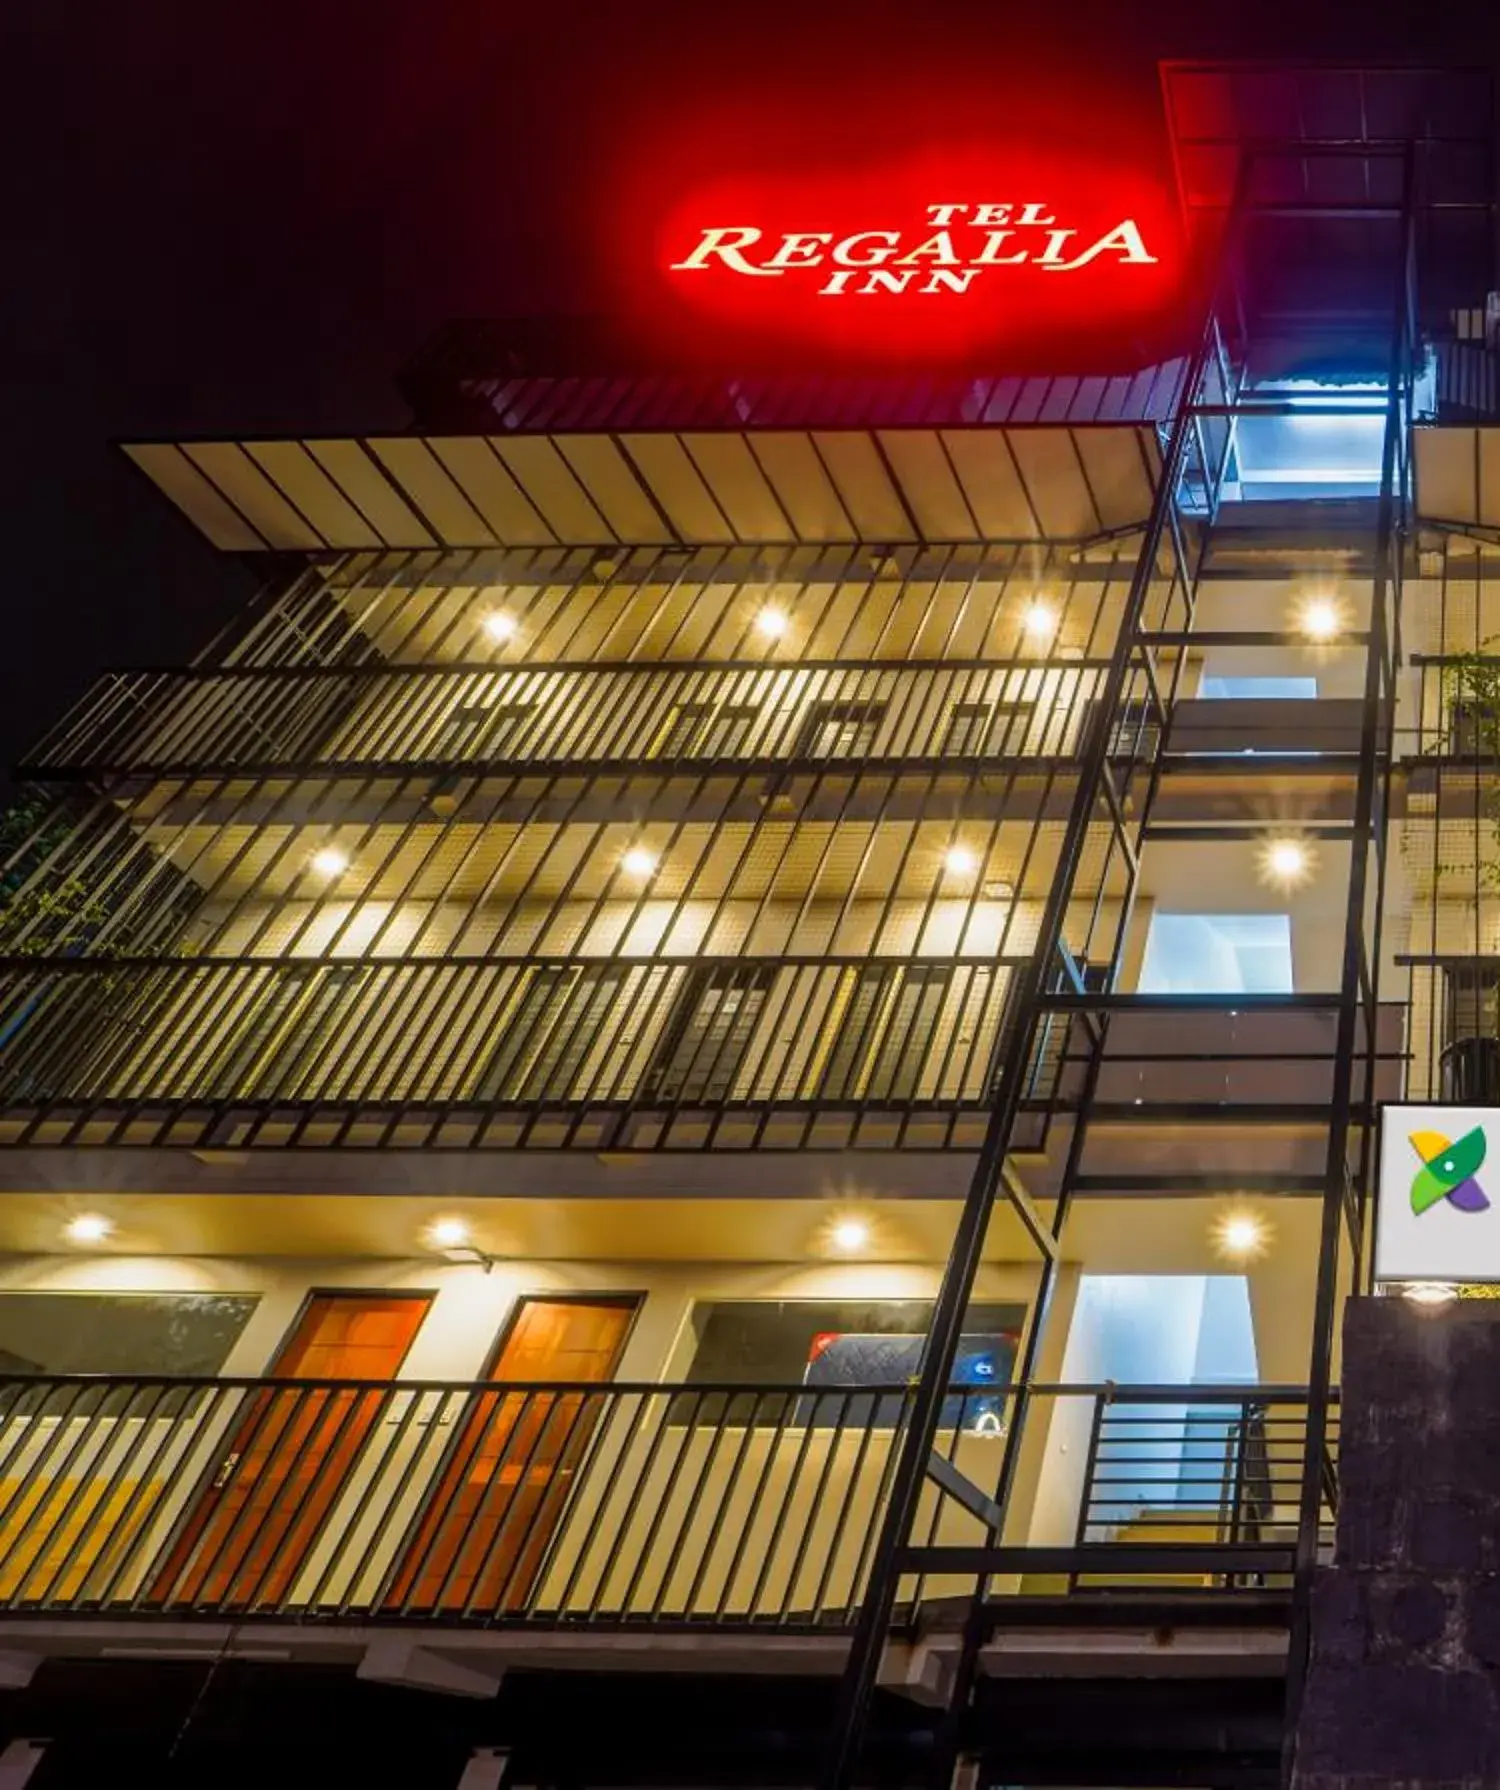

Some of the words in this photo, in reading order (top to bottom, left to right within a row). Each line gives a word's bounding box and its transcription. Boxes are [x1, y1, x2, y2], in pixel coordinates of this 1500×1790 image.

[926, 203, 1055, 226] TEL
[670, 219, 1158, 277] REGALIA
[817, 269, 982, 296] INN
